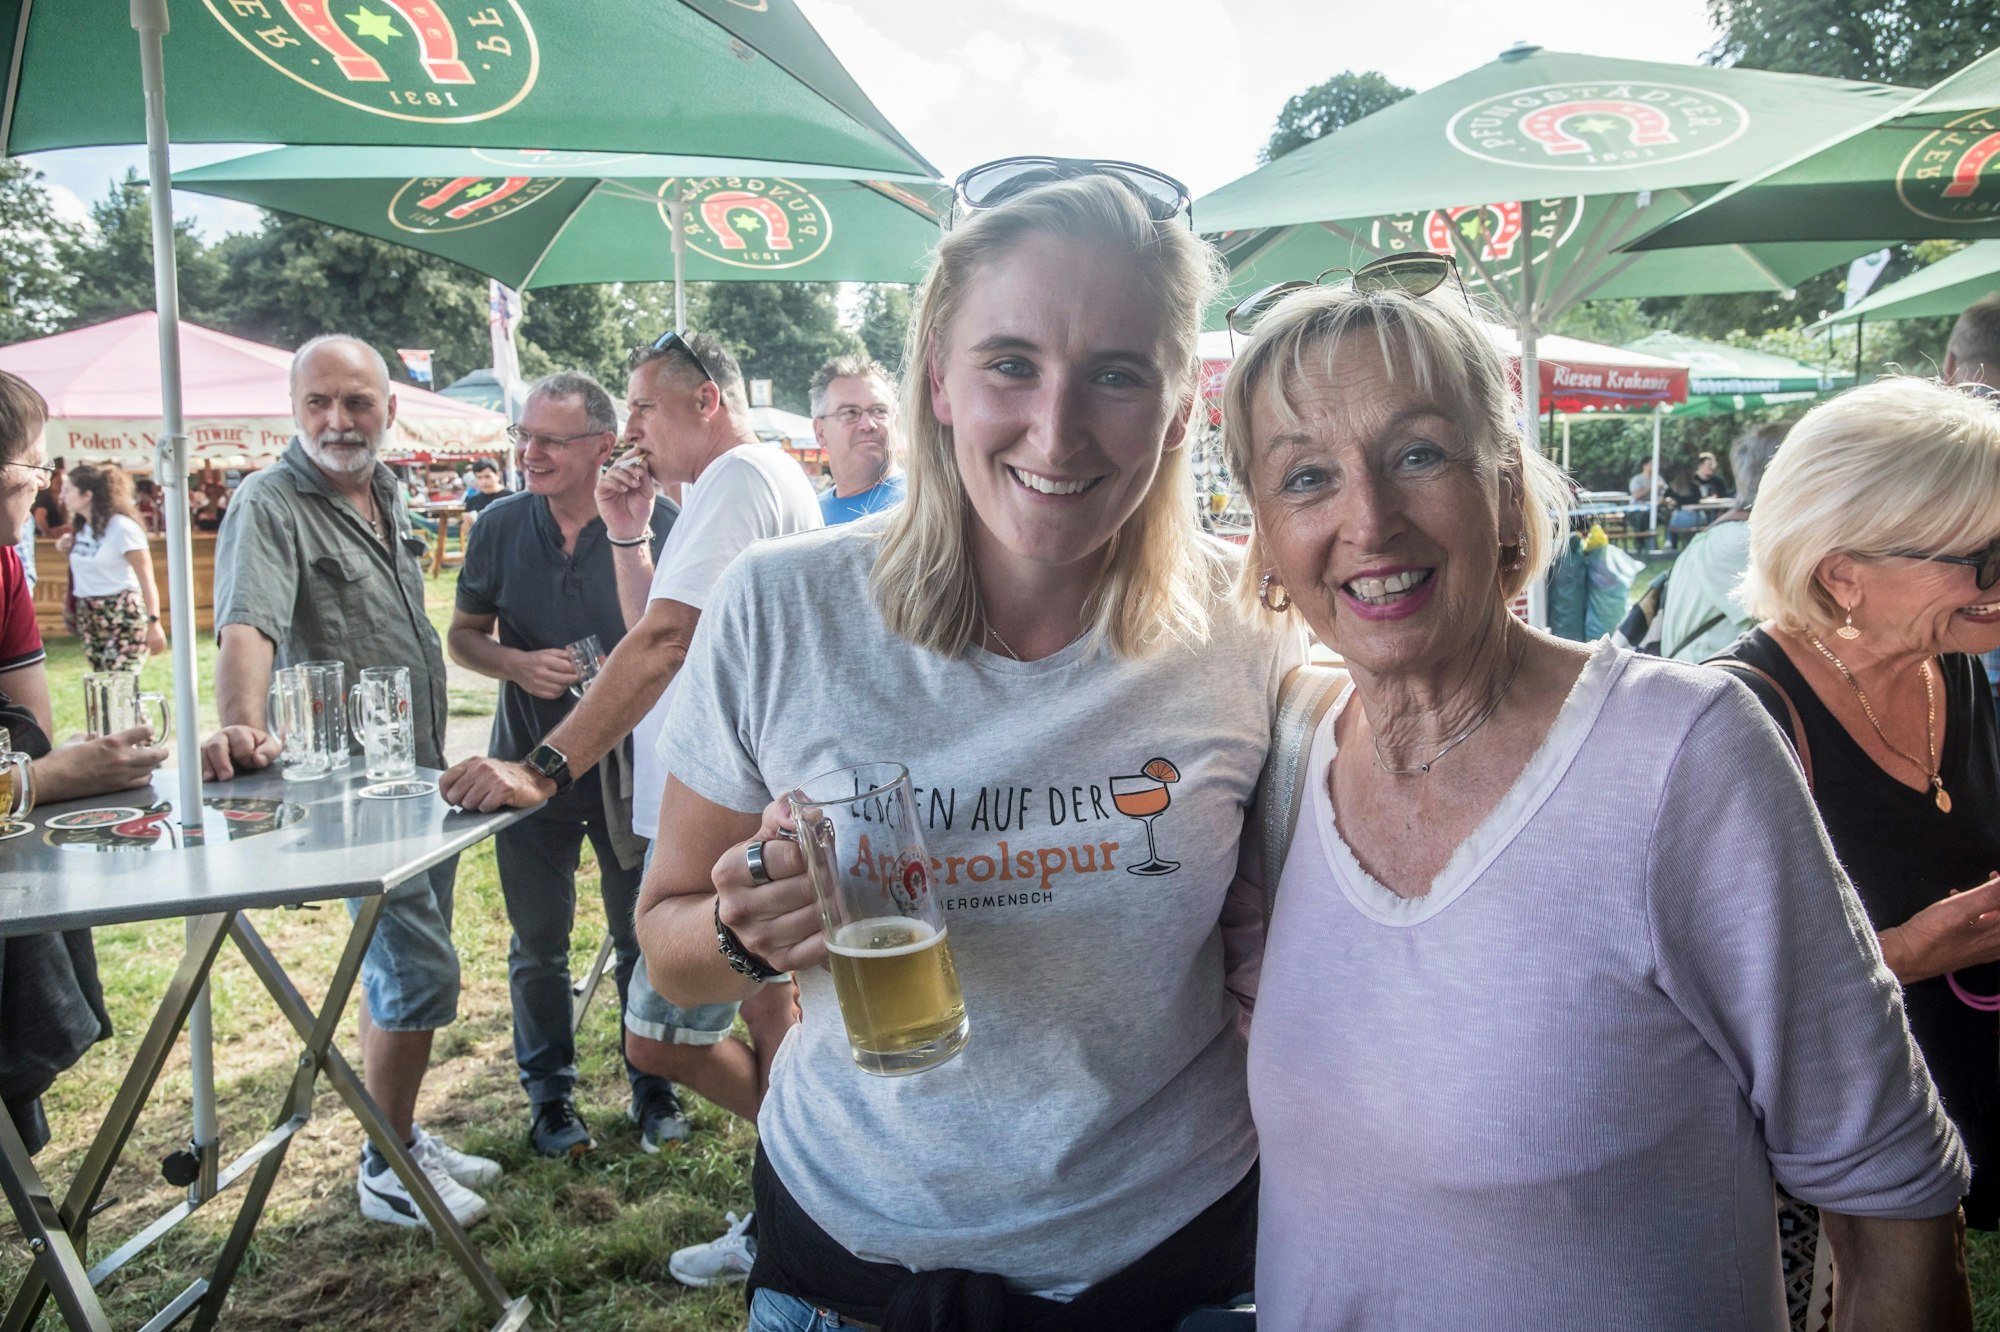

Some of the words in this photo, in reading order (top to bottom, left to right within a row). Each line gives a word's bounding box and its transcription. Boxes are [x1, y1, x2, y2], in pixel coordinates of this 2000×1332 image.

[1552, 366, 1602, 387] Riesen
[1606, 369, 1670, 390] Krakauer
[68, 432, 138, 449] Polen's
[971, 786, 1032, 832] AUF
[1048, 784, 1110, 827] DER
